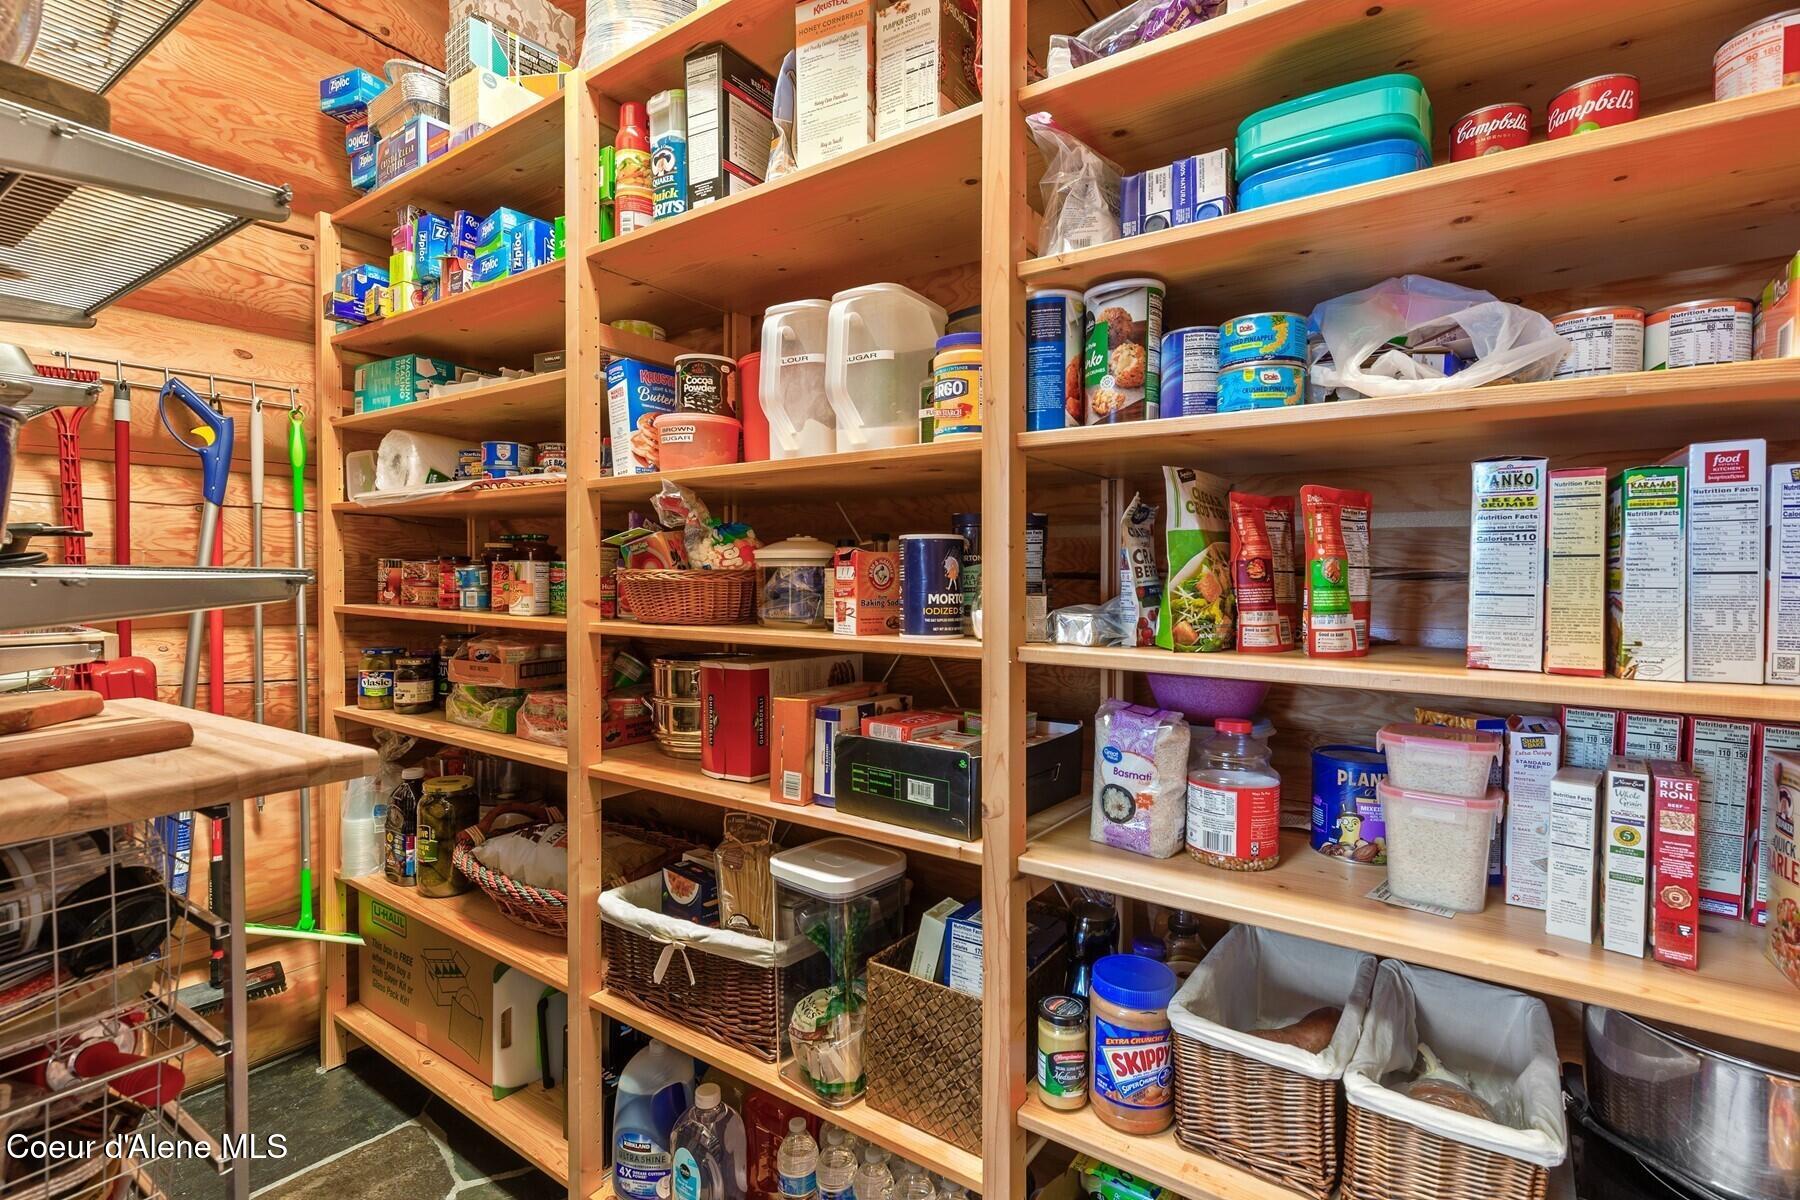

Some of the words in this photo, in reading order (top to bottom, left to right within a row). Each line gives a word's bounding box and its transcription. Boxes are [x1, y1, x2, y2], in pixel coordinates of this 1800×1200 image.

[798, 23, 821, 36] HONEY
[822, 9, 864, 28] CORNBREAD
[330, 76, 350, 92] Ziploc
[1549, 89, 1634, 133] Campbell's
[1457, 112, 1528, 144] Campbell's
[348, 131, 368, 148] Ziploc
[359, 152, 374, 168] Ziploc
[652, 175, 674, 188] QUAKER
[653, 200, 684, 216] RITS
[481, 219, 495, 238] Ziploc
[514, 232, 523, 268] Ziploc
[481, 258, 498, 273] Ziploc
[1670, 309, 1705, 319] Nutrition
[1239, 324, 1254, 334] Dole
[1555, 318, 1584, 329] Nutrition
[1670, 328, 1693, 336] Calories
[1244, 334, 1274, 343] PINEAPPLE
[782, 354, 808, 364] LOUR
[640, 370, 676, 387] KRUST
[686, 376, 714, 385] Cocoa
[1264, 373, 1280, 381] Dole
[684, 384, 716, 393] Powder
[1712, 453, 1741, 467] food
[1485, 472, 1534, 488] ANKO
[861, 600, 885, 608] Baking
[923, 607, 958, 615] IODIZED
[1104, 748, 1119, 758] Great
[1665, 744, 1676, 752] 150
[1516, 759, 1551, 767] STANDARD
[1113, 767, 1152, 781] Basmati
[1660, 780, 1693, 791] RICE
[1553, 792, 1576, 800] Nutrition
[1615, 789, 1640, 799] Whole
[1660, 790, 1694, 801] RONI
[1620, 798, 1642, 807] Grain
[1610, 810, 1645, 819] COUSCOUS
[1624, 831, 1631, 840] 5
[1768, 846, 1800, 886] ARLE
[374, 905, 405, 928] U-HAUL
[953, 924, 972, 932] Nutrition
[952, 943, 968, 951] Calories
[372, 953, 385, 966] when
[386, 961, 395, 972] you
[400, 952, 414, 967] FREE
[372, 964, 383, 978] Dish
[386, 987, 398, 1000] Pack
[1131, 1036, 1164, 1044] CRUNCHY
[1112, 1046, 1171, 1077] SKIPPY
[623, 1140, 650, 1149] KIRKLAND
[620, 1166, 632, 1178] 4X
